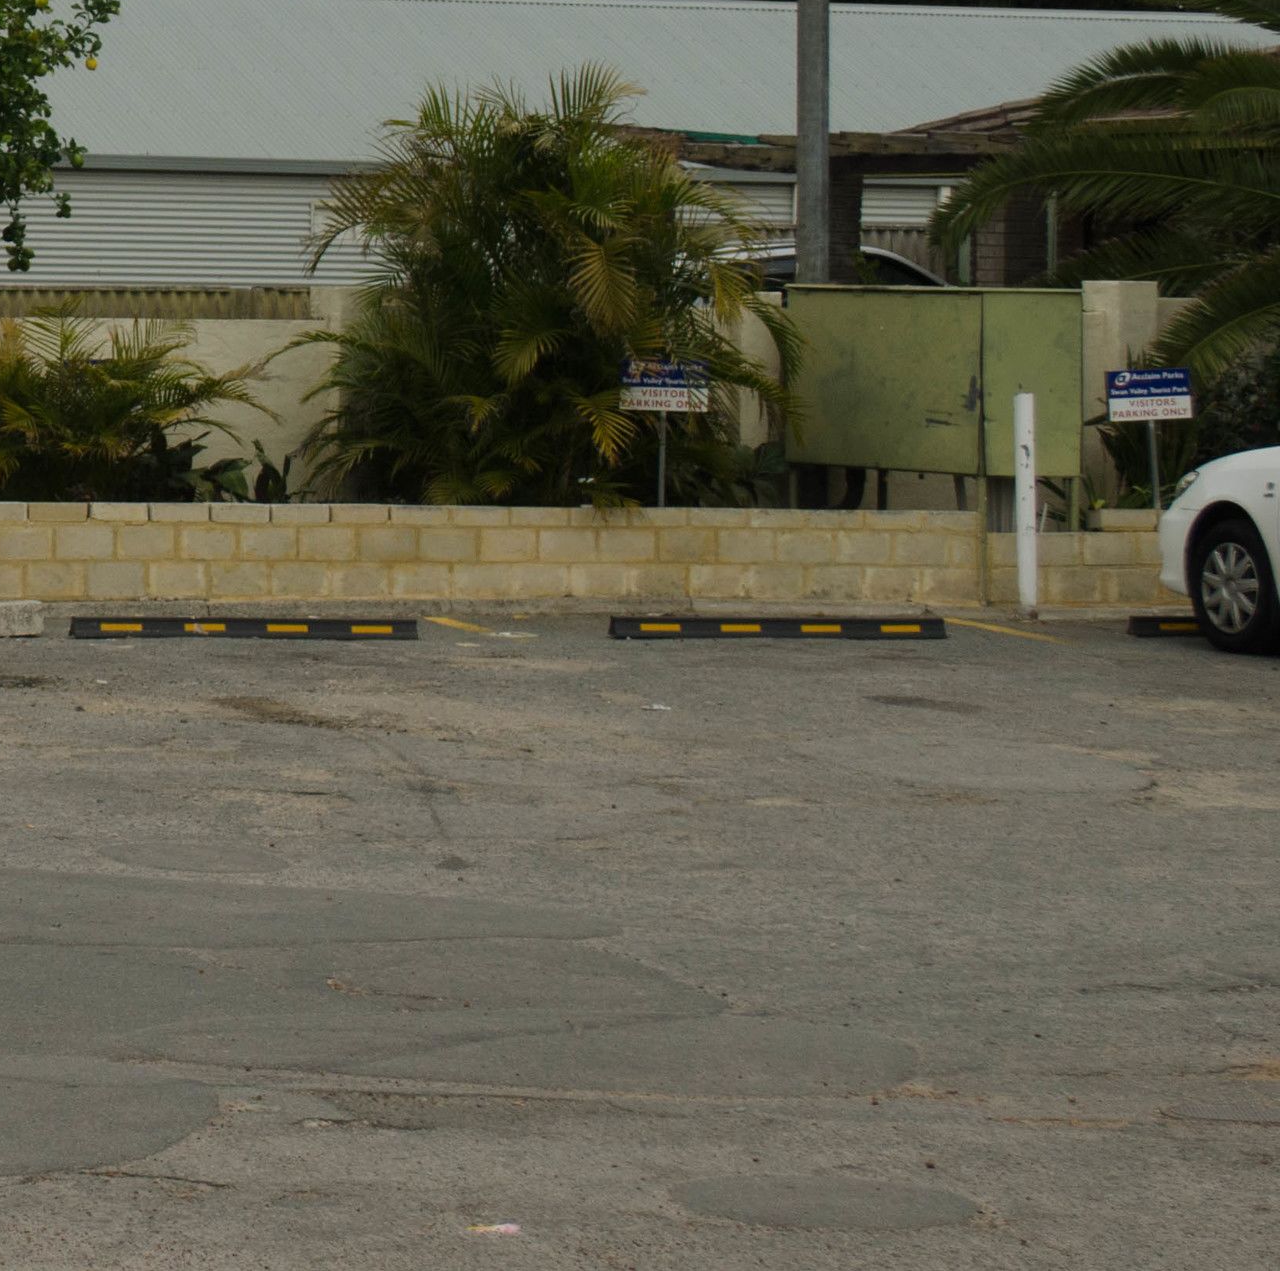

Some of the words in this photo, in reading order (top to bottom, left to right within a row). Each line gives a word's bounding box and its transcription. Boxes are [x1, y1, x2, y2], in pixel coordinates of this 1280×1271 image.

[1128, 397, 1177, 407] VISITORS
[1112, 408, 1159, 419] PARKING
[1162, 407, 1188, 417] ONLY
